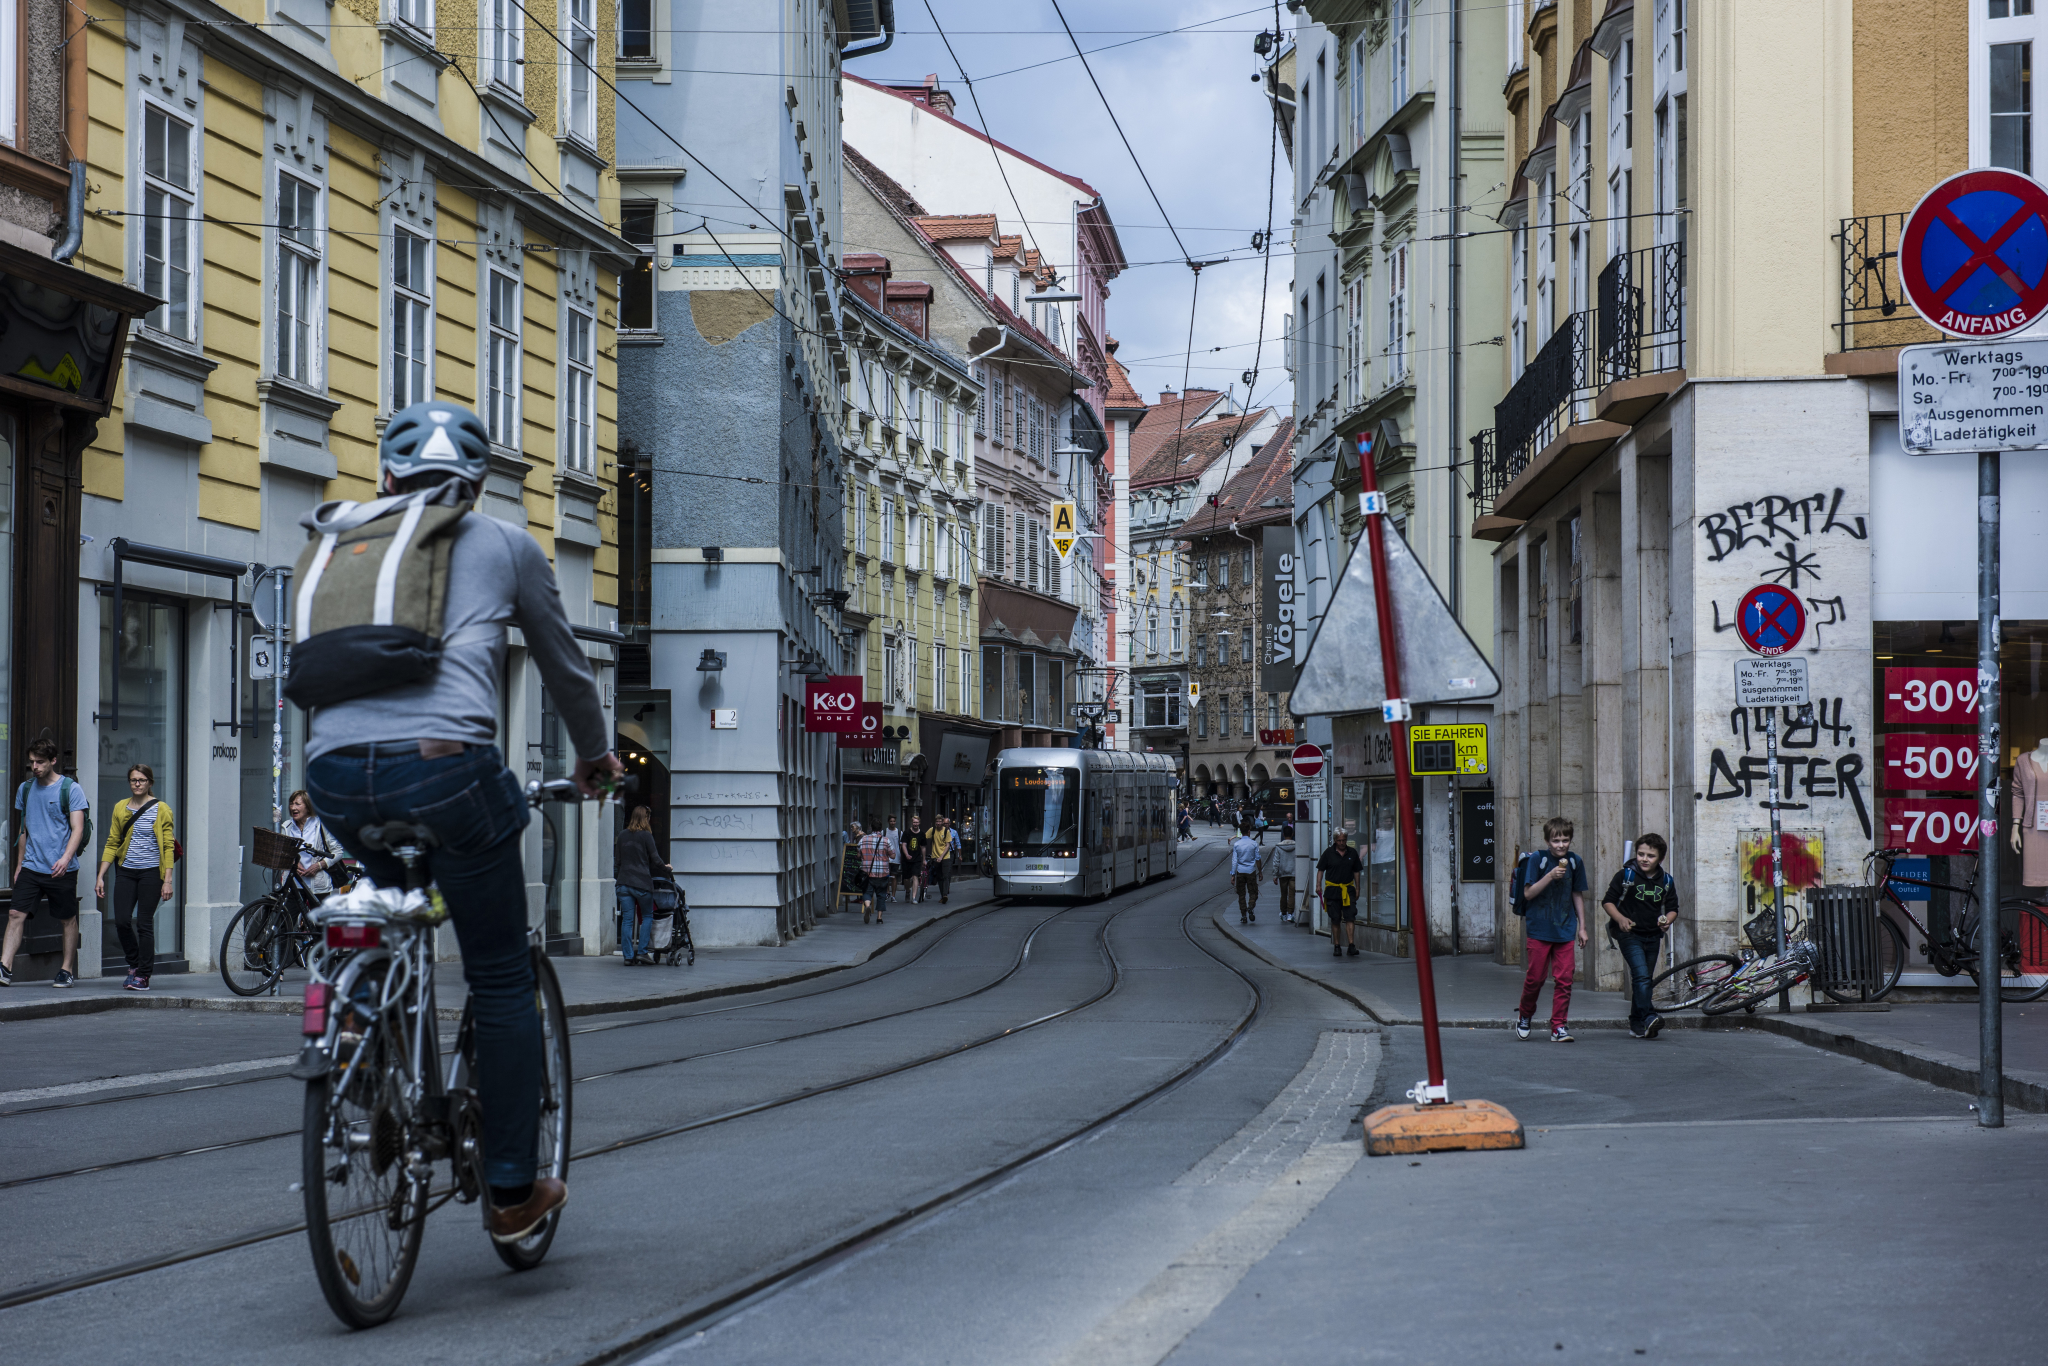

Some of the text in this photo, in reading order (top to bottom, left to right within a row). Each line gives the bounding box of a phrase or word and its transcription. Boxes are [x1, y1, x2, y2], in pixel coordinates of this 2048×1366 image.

[1939, 307, 2027, 333] ANFANG
[1944, 351, 2023, 366] Werktags
[1913, 391, 1938, 405] Sa.
[1928, 405, 2044, 423] Ausgenommen
[1934, 423, 2036, 441] Ladetätigkeit
[1055, 507, 1071, 529] A
[1698, 487, 1868, 562] BERTL
[1056, 539, 1070, 552] 15
[1273, 553, 1295, 664] Vögele
[1760, 646, 1785, 655] ENDE
[1751, 661, 1792, 669] Werktags
[1191, 684, 1198, 696] A
[1742, 686, 1804, 694] ausgenommen
[1888, 680, 1978, 714] -30%
[813, 692, 856, 711] K&O
[1746, 694, 1800, 704] Ladetätigkeit
[730, 710, 736, 722] 2
[1414, 728, 1484, 740] SIE FAHREN
[212, 742, 238, 762] prokopp
[873, 748, 897, 764] SATTLER
[1458, 743, 1478, 754] km
[1888, 746, 1978, 780] -50%
[1890, 810, 1979, 846] -70%
